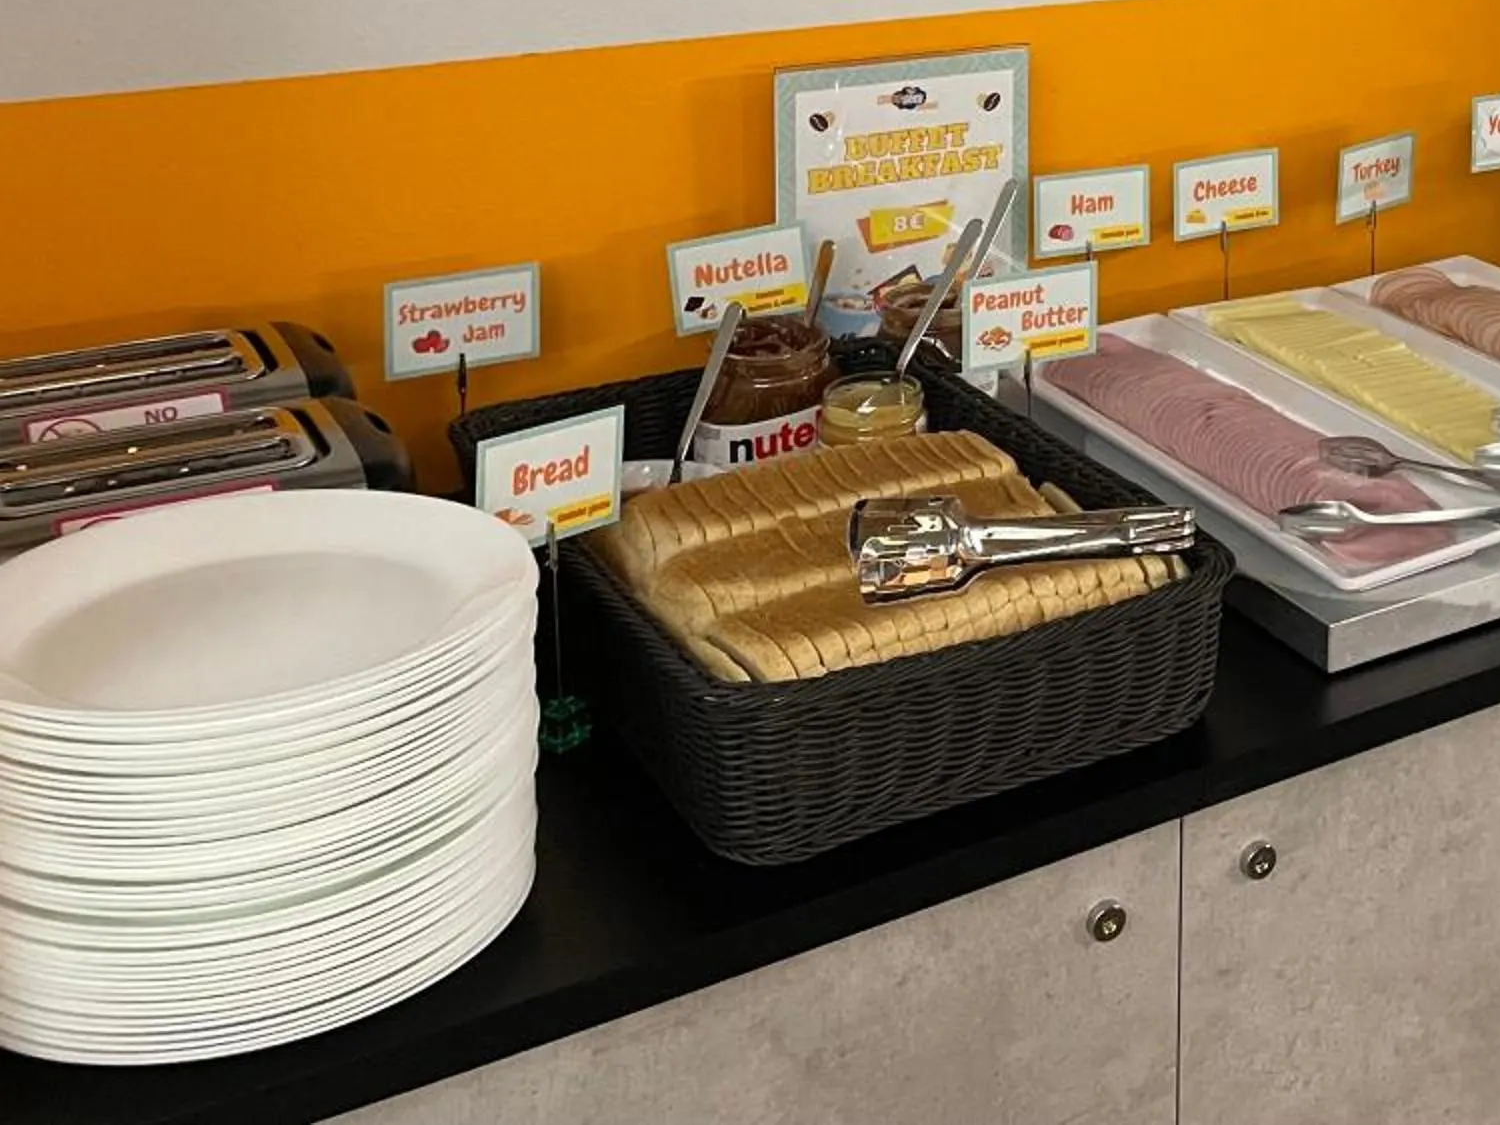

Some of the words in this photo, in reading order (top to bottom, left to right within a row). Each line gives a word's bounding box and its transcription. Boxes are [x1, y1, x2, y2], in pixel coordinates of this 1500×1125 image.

[844, 122, 970, 162] BUFFET
[807, 143, 1004, 195] BREAKFAST
[1352, 153, 1401, 185] Turkey
[1071, 192, 1114, 216] Ham
[1193, 174, 1258, 203] Cheese
[693, 251, 789, 289] Nutella
[398, 290, 526, 325] Strawberry
[971, 283, 1046, 313] Peanut
[463, 320, 506, 345] Jam
[1021, 304, 1089, 333] Butter
[143, 405, 179, 425] NO
[512, 446, 590, 496] Bread
